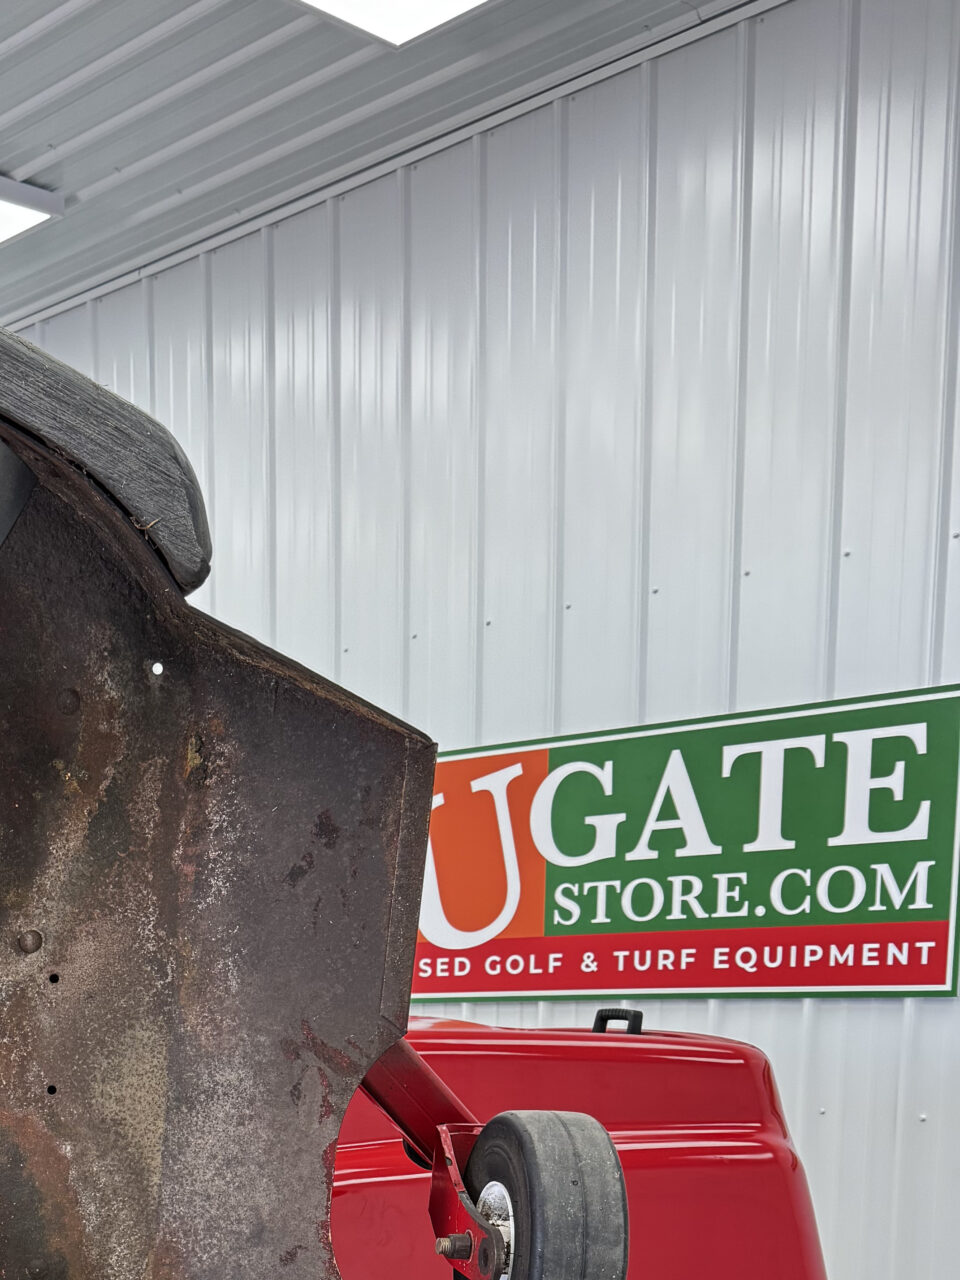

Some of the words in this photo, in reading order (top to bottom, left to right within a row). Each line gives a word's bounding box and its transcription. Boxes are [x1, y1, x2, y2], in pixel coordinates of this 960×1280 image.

[553, 860, 937, 926] STORE.COM
[417, 957, 471, 978] SED
[484, 953, 563, 976] GOLF
[580, 951, 598, 973] &
[613, 948, 697, 972] TURF
[713, 941, 937, 972] EQUIPMENT
